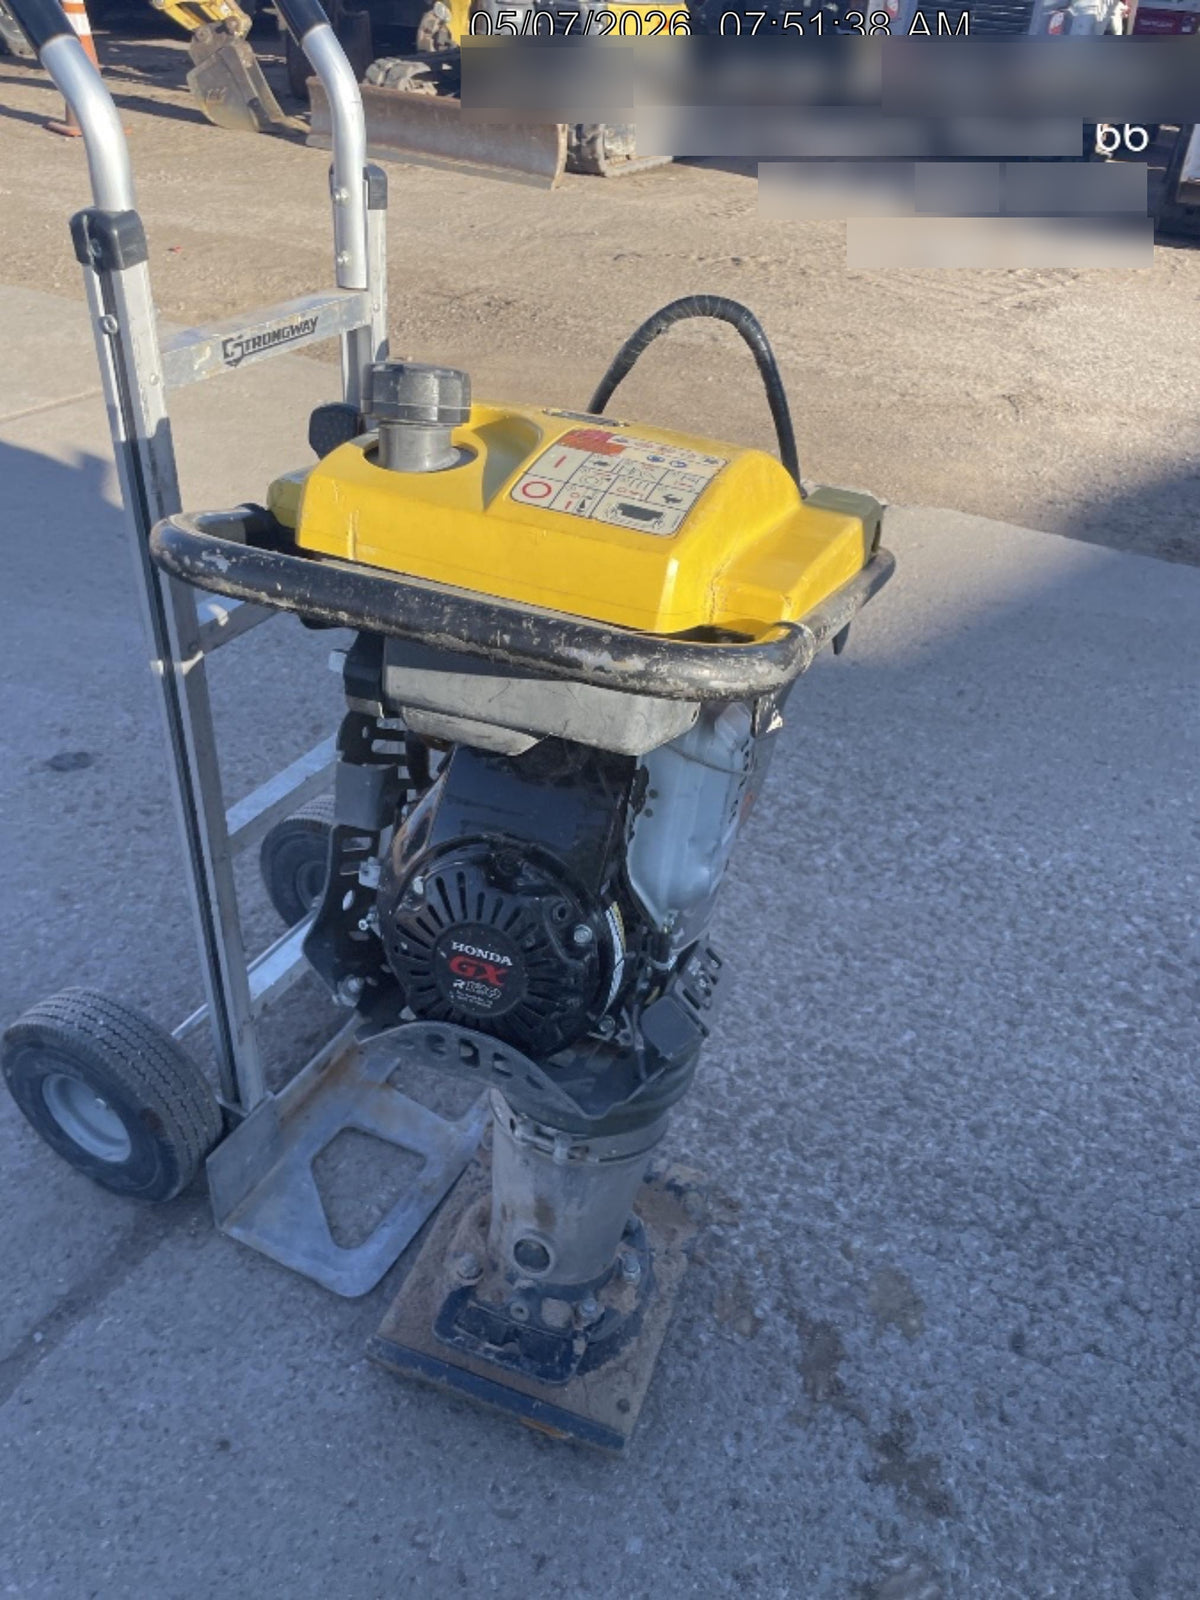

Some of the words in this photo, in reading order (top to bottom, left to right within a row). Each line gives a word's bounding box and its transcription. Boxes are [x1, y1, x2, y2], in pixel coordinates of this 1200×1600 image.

[222, 316, 319, 367] STRONGWAY
[451, 942, 513, 966] HONDA
[449, 956, 508, 988] GX
